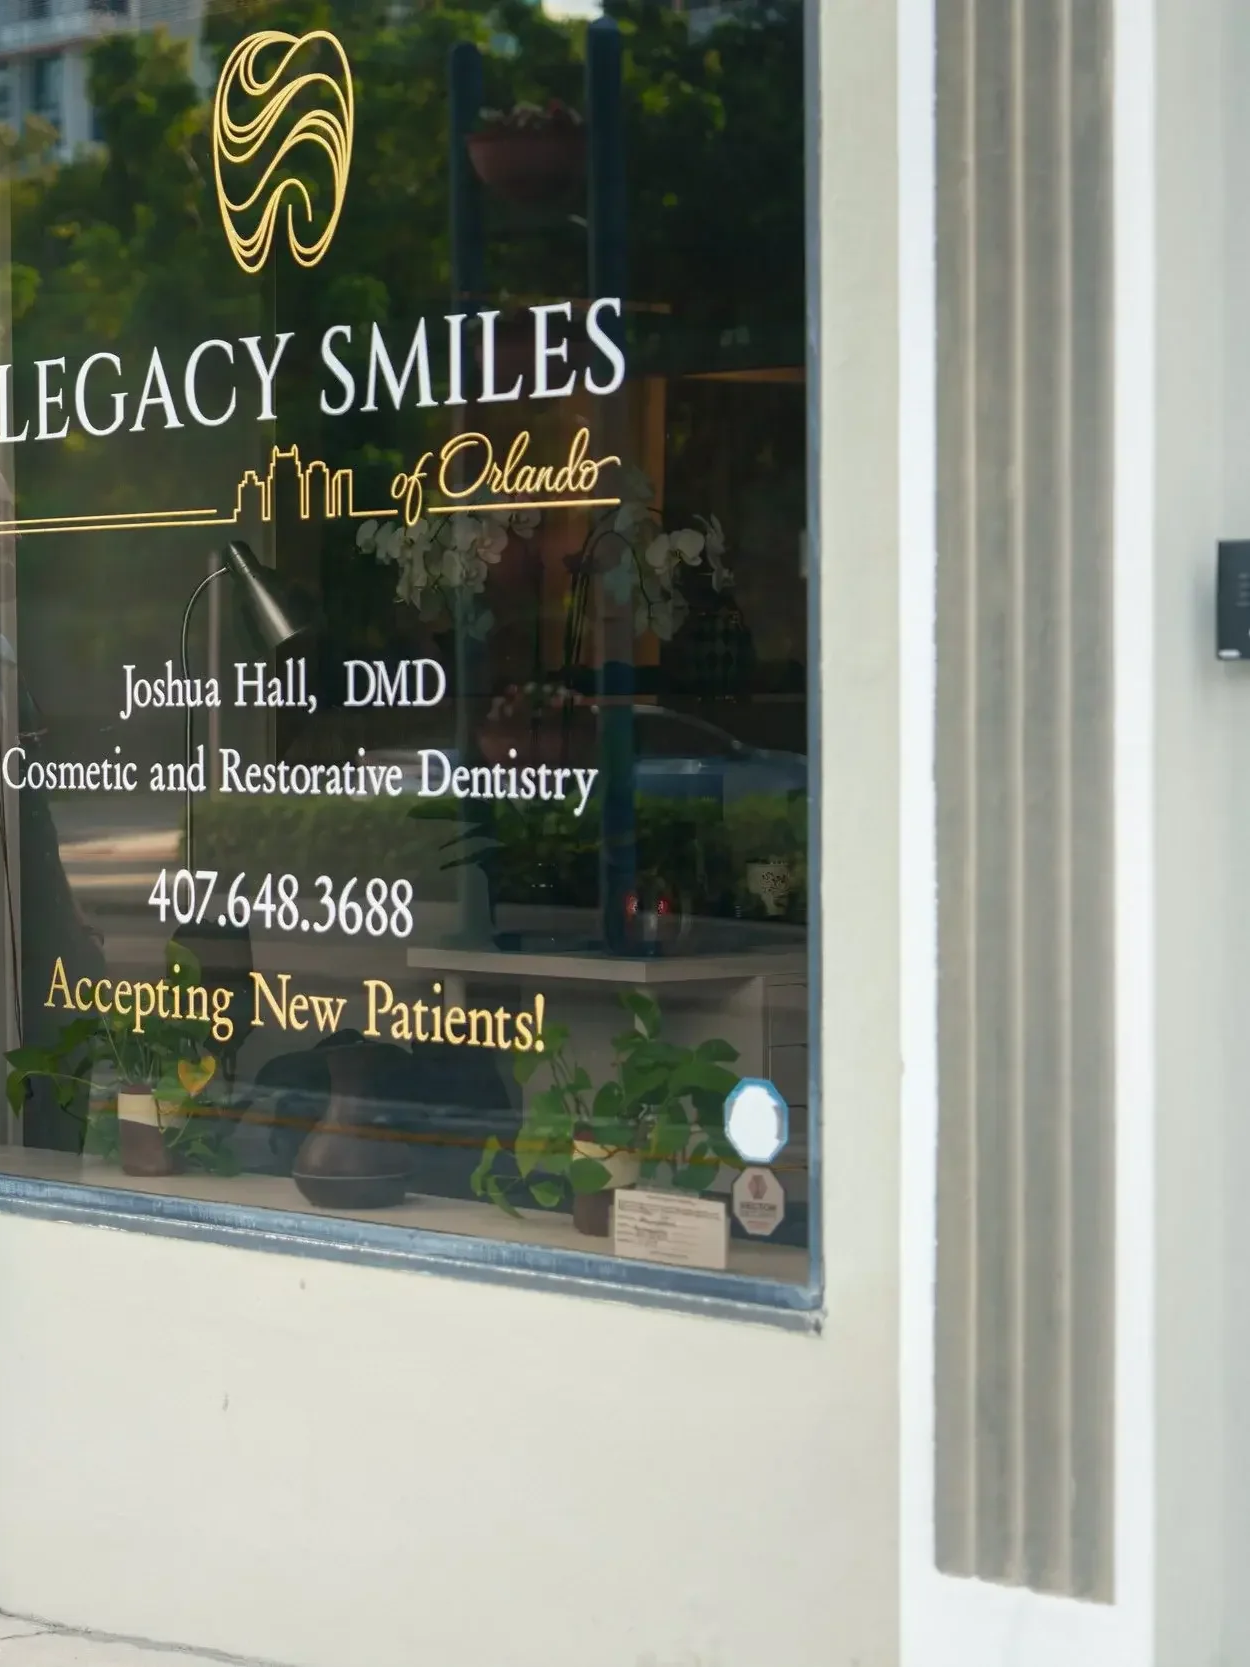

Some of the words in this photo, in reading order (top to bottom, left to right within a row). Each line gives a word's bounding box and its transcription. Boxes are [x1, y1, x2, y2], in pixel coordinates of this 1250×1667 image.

[320, 297, 626, 416] SMILES
[391, 451, 434, 527] of
[438, 427, 621, 499] Orlando
[119, 661, 222, 720] Joshua
[234, 657, 318, 713] Hall,
[343, 658, 447, 707] DMD
[2, 746, 138, 792] Cosmetic
[150, 745, 207, 793] and
[219, 747, 403, 797] Restorative
[417, 748, 599, 816] Dentistry
[148, 868, 414, 938] 407.648.3688
[43, 956, 235, 1042] Accepting
[249, 971, 348, 1034] New
[363, 979, 546, 1053] Patients!
